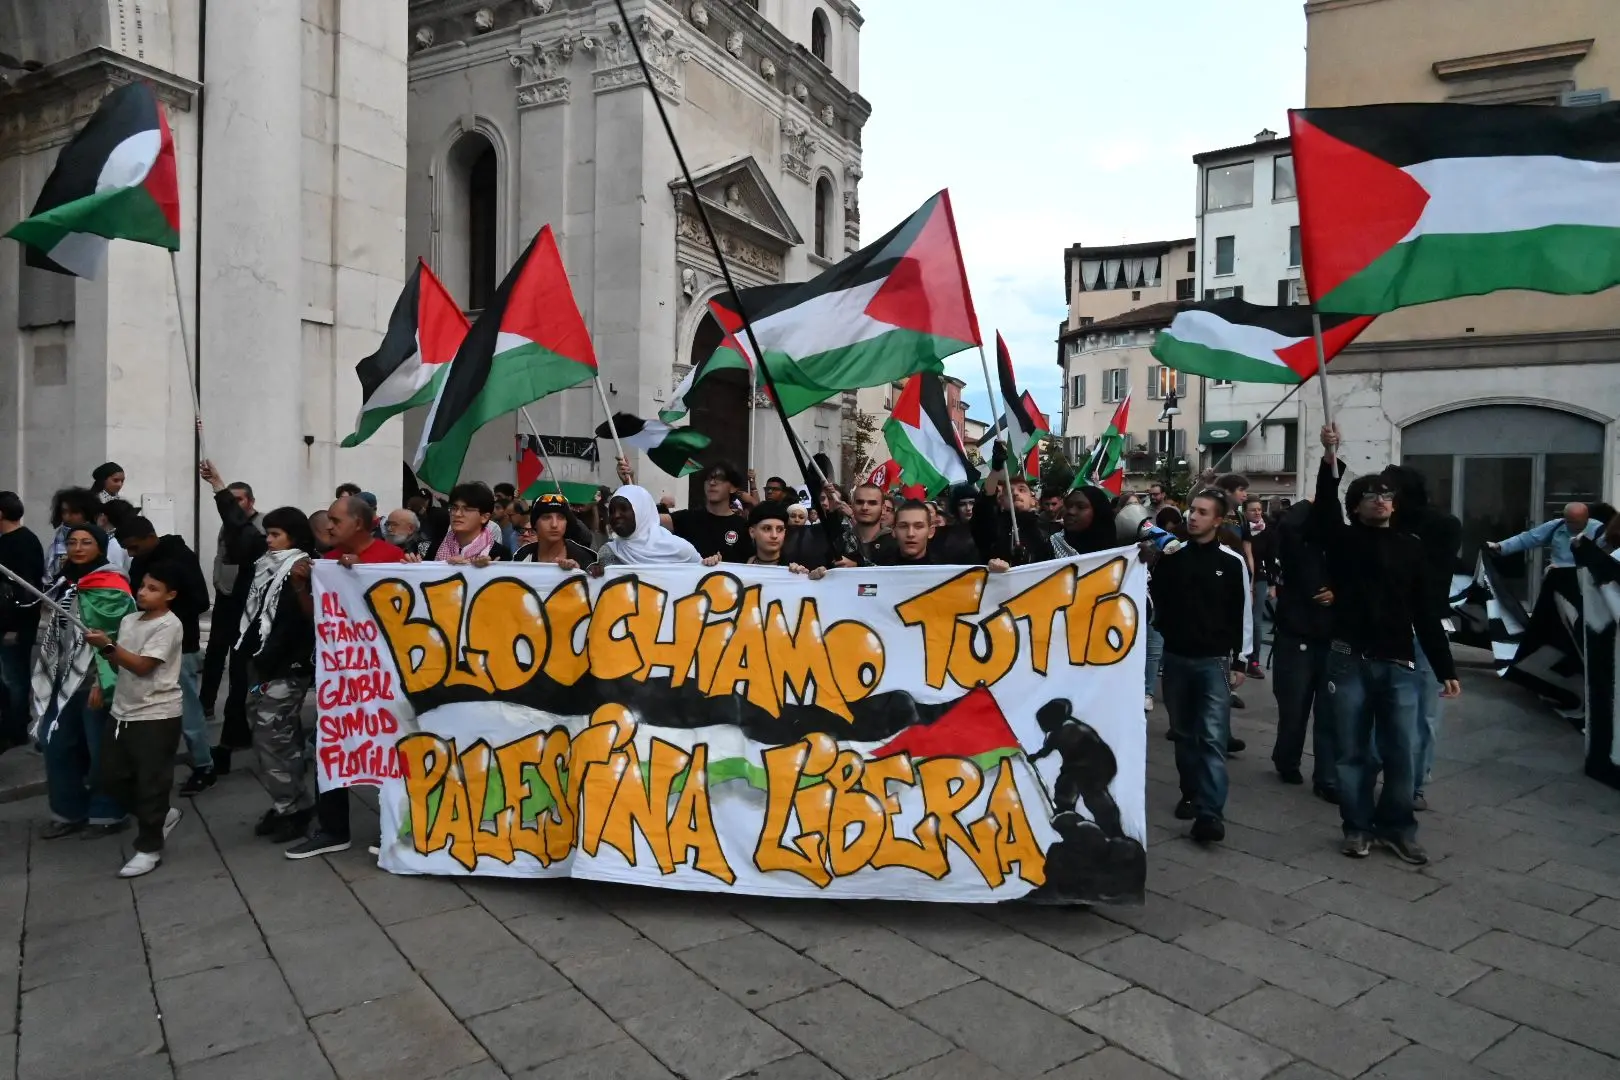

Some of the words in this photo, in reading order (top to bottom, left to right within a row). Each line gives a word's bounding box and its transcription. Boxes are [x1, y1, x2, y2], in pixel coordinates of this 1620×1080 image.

[321, 592, 348, 618] AL
[894, 556, 1139, 689] TUTTO
[321, 646, 381, 671] DELLA
[318, 671, 395, 711] GLOBAL
[319, 708, 398, 743] SUMUD
